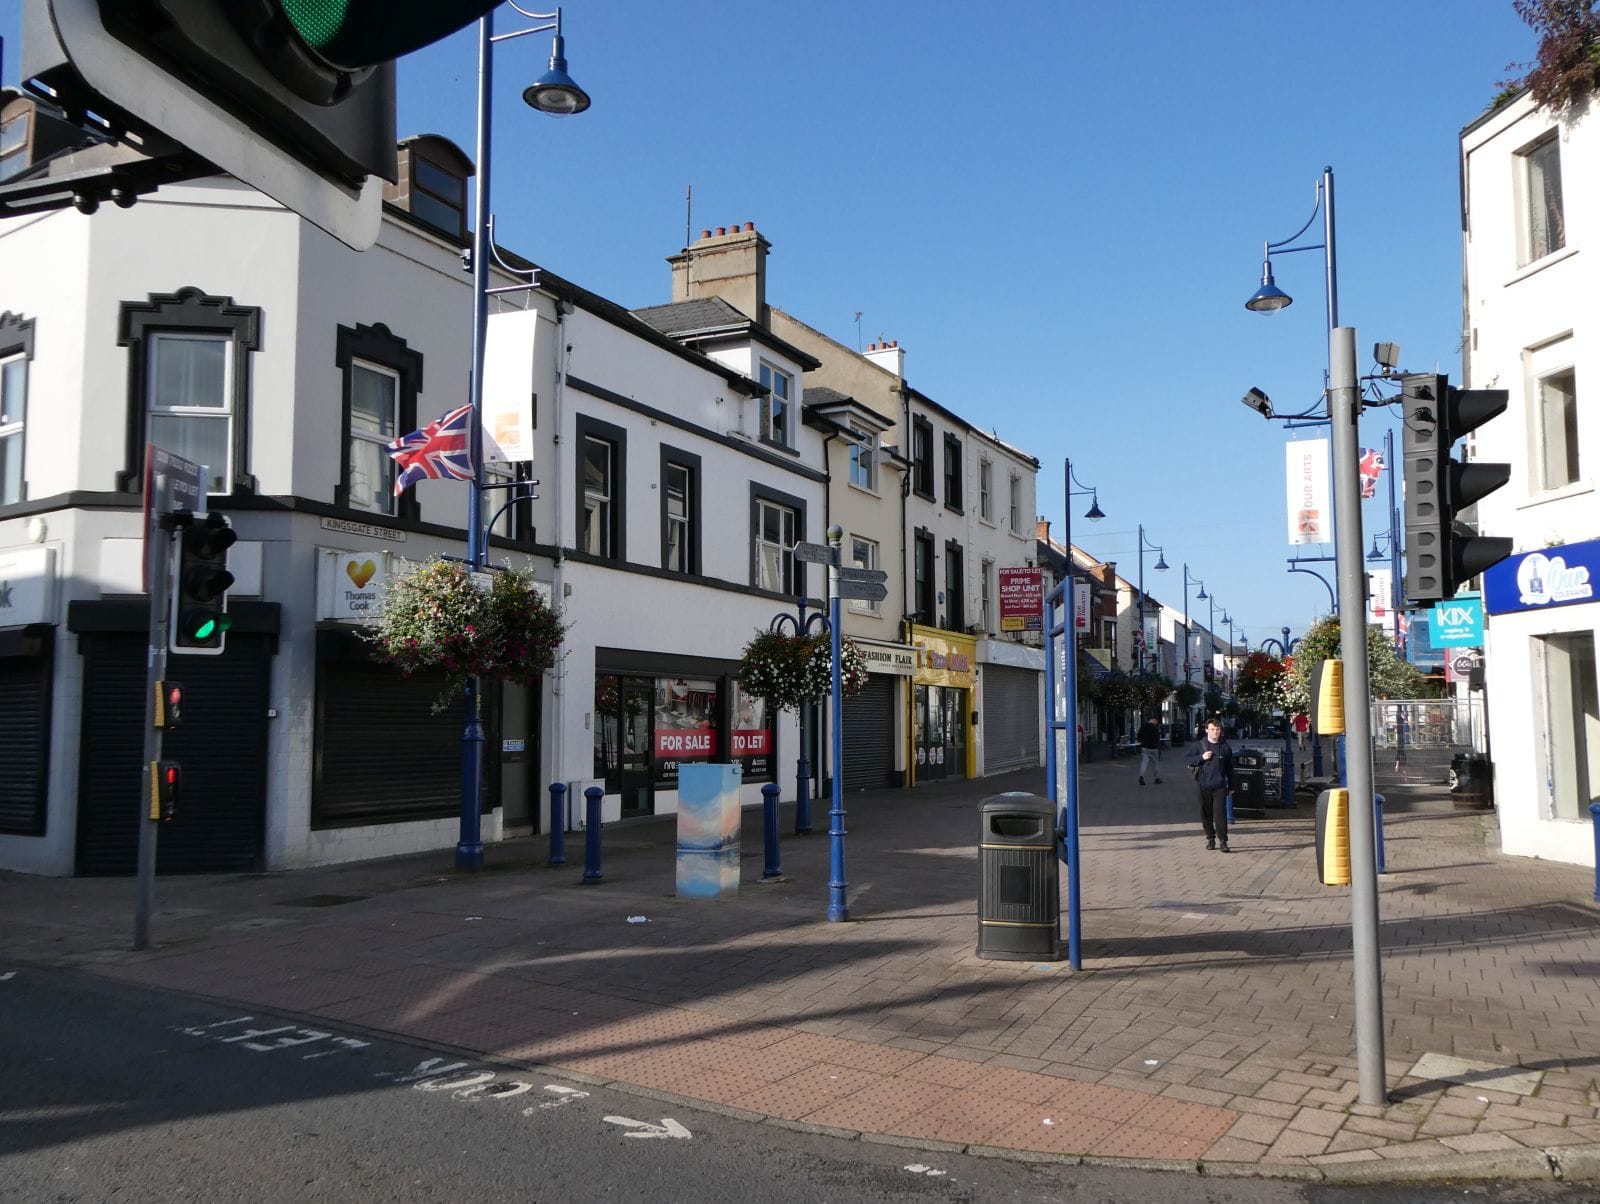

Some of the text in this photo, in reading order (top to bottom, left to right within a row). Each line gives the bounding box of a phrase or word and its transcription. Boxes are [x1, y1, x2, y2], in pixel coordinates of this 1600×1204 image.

[1304, 454, 1313, 508] OUR ARTS
[326, 519, 402, 540] KINGSGATE STREET
[1010, 577, 1031, 585] PRIME
[344, 591, 376, 600] Thomas
[1001, 584, 1040, 593] SHOP UNIT
[349, 601, 370, 611] Cook
[1436, 606, 1474, 627] KIX
[863, 650, 912, 665] FASHION FLAIR
[660, 735, 710, 750] FOR SALE
[733, 735, 763, 749] TO LET
